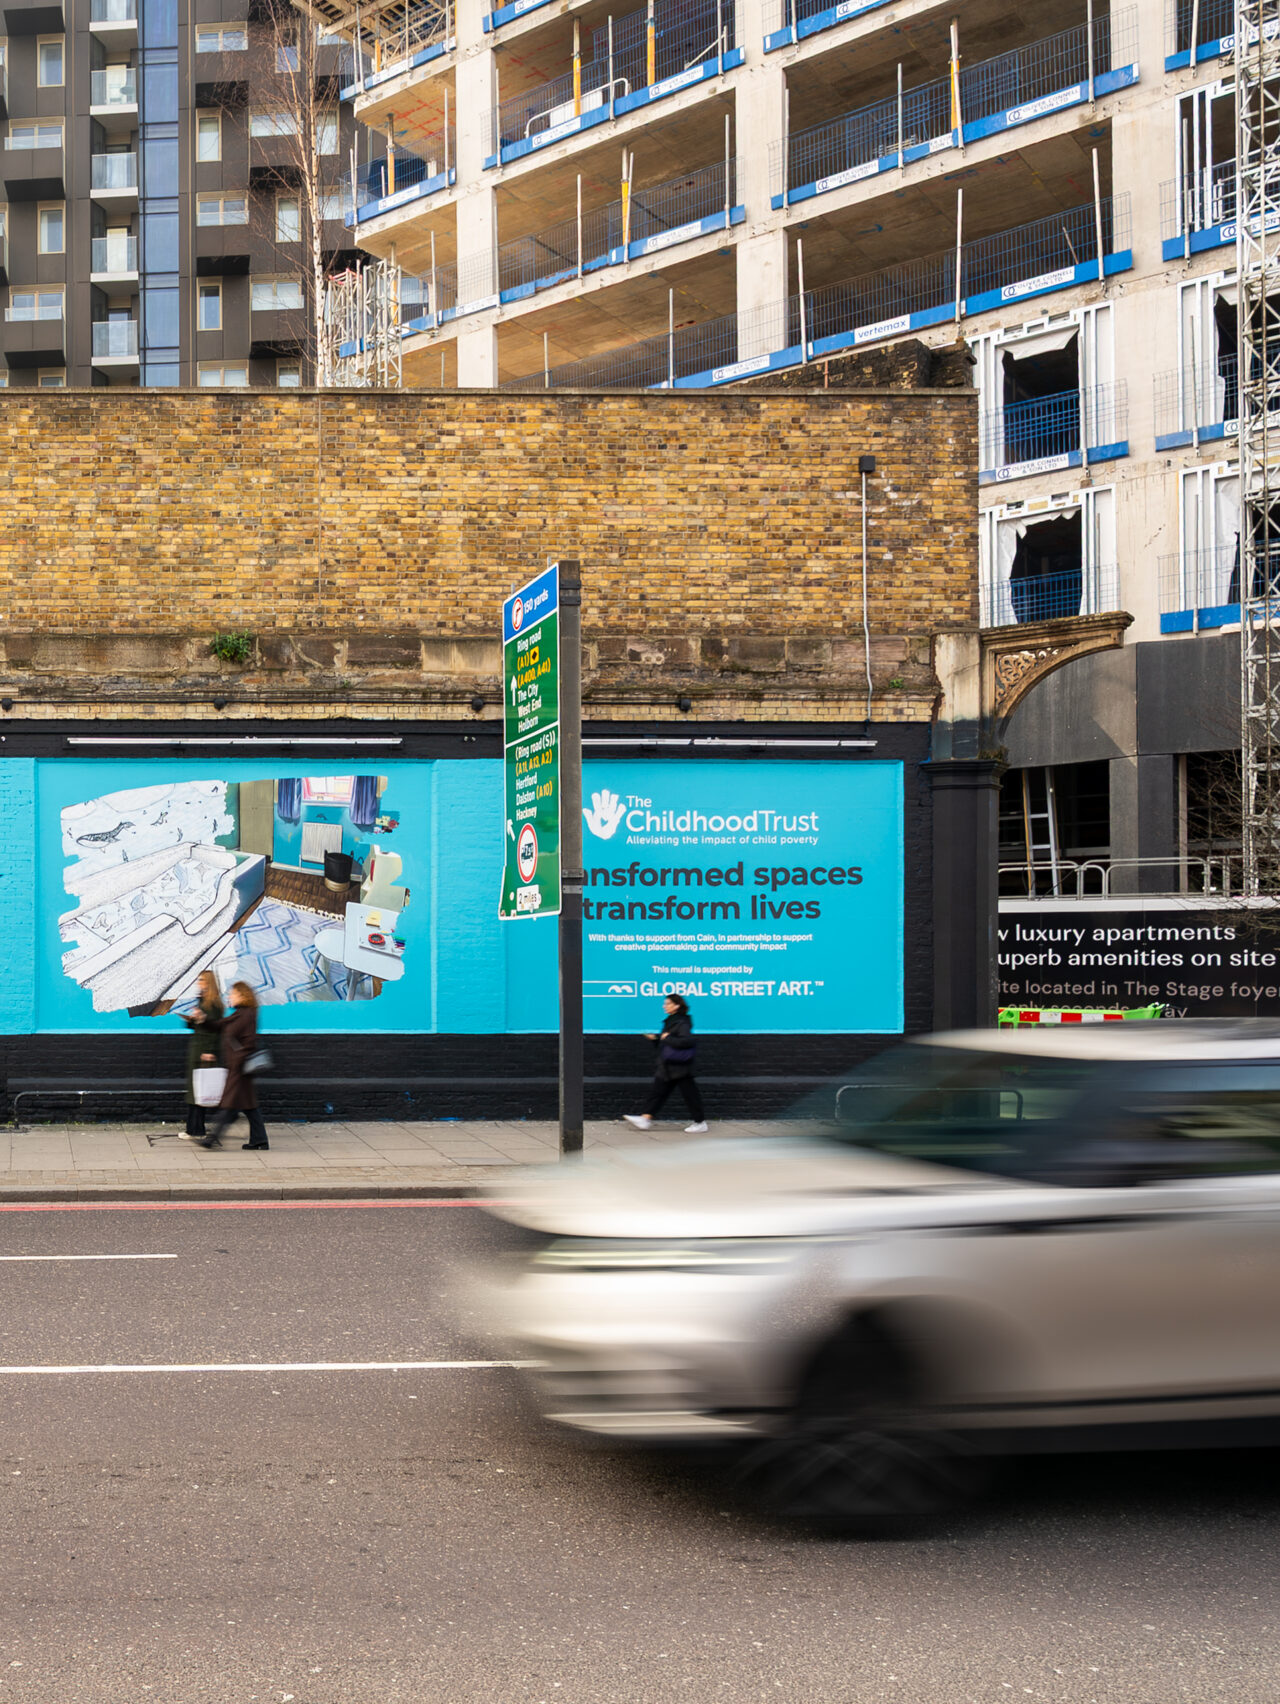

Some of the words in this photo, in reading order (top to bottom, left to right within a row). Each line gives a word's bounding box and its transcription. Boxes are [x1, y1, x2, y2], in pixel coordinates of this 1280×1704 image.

[857, 318, 907, 339] vertemax
[524, 598, 532, 614] 150
[534, 589, 548, 610] yards
[517, 638, 528, 653] Ring
[530, 627, 541, 645] road
[517, 651, 529, 671] (A1)
[518, 690, 527, 702] The
[528, 683, 538, 697] City
[518, 702, 530, 718] West
[532, 696, 541, 711] End
[518, 716, 538, 733] Holborn
[516, 772, 537, 790] Hertford
[516, 791, 535, 806] Dalston
[536, 780, 552, 800] (A10)
[626, 796, 651, 807] The
[516, 806, 537, 821] Hackney
[627, 836, 679, 846] Alleviating
[682, 836, 698, 844] the
[702, 836, 736, 845] impact
[753, 836, 776, 844] child
[781, 836, 818, 845] poverty
[754, 866, 863, 892] spaces
[519, 893, 522, 904] 2
[584, 896, 740, 920] transform
[752, 894, 820, 919] lives
[727, 934, 771, 942] partnership
[783, 934, 812, 942] support
[1016, 924, 1085, 946] luxury
[1093, 926, 1235, 945] apartments
[648, 943, 697, 952] placemaking
[715, 943, 758, 951] community
[760, 943, 787, 951] impact
[998, 949, 1061, 970] uperb
[1069, 950, 1183, 966] amenities
[1191, 954, 1220, 966] on
[1230, 950, 1275, 966] site
[703, 966, 742, 974] supported
[743, 966, 753, 974] by
[641, 982, 707, 996] GLOBAL
[711, 981, 775, 996] STREET
[1026, 980, 1094, 994] located
[1102, 981, 1117, 994] in
[1124, 981, 1159, 995] The
[1167, 982, 1223, 1000] Stage
